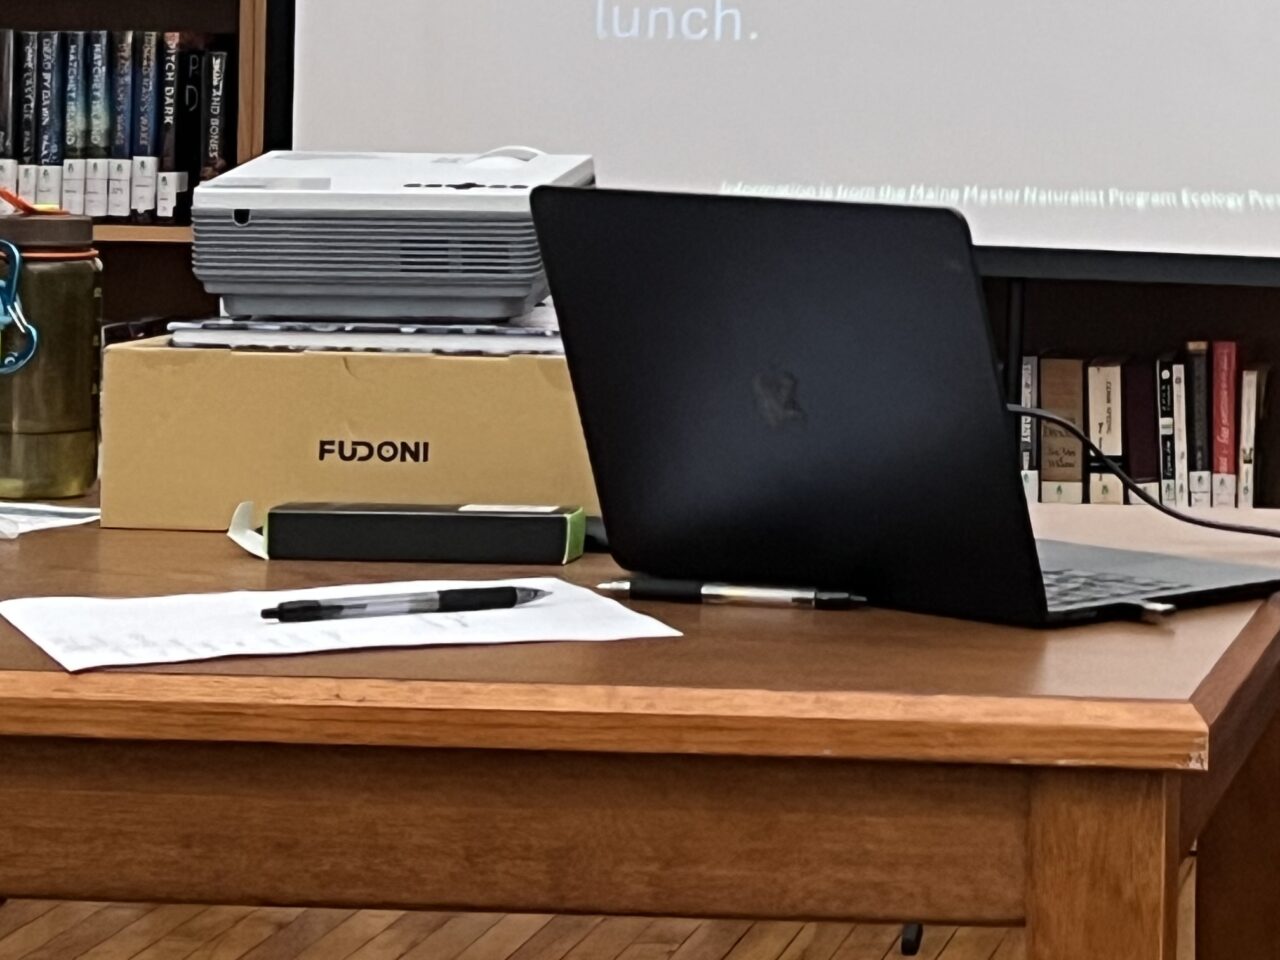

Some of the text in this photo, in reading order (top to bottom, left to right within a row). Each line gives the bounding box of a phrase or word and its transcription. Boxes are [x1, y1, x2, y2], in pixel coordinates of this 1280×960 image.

[67, 44, 77, 97] HATCHET
[92, 43, 102, 96] HATCHET
[163, 42, 175, 126] PITCH DARK
[208, 117, 220, 158] BONES
[879, 183, 905, 202] the
[907, 183, 959, 204] Maine
[962, 185, 1020, 207] Master
[1022, 185, 1104, 209] Naturalist
[1108, 187, 1177, 211] Program
[1180, 188, 1245, 212] Ecology
[318, 440, 430, 463] FUDONI
